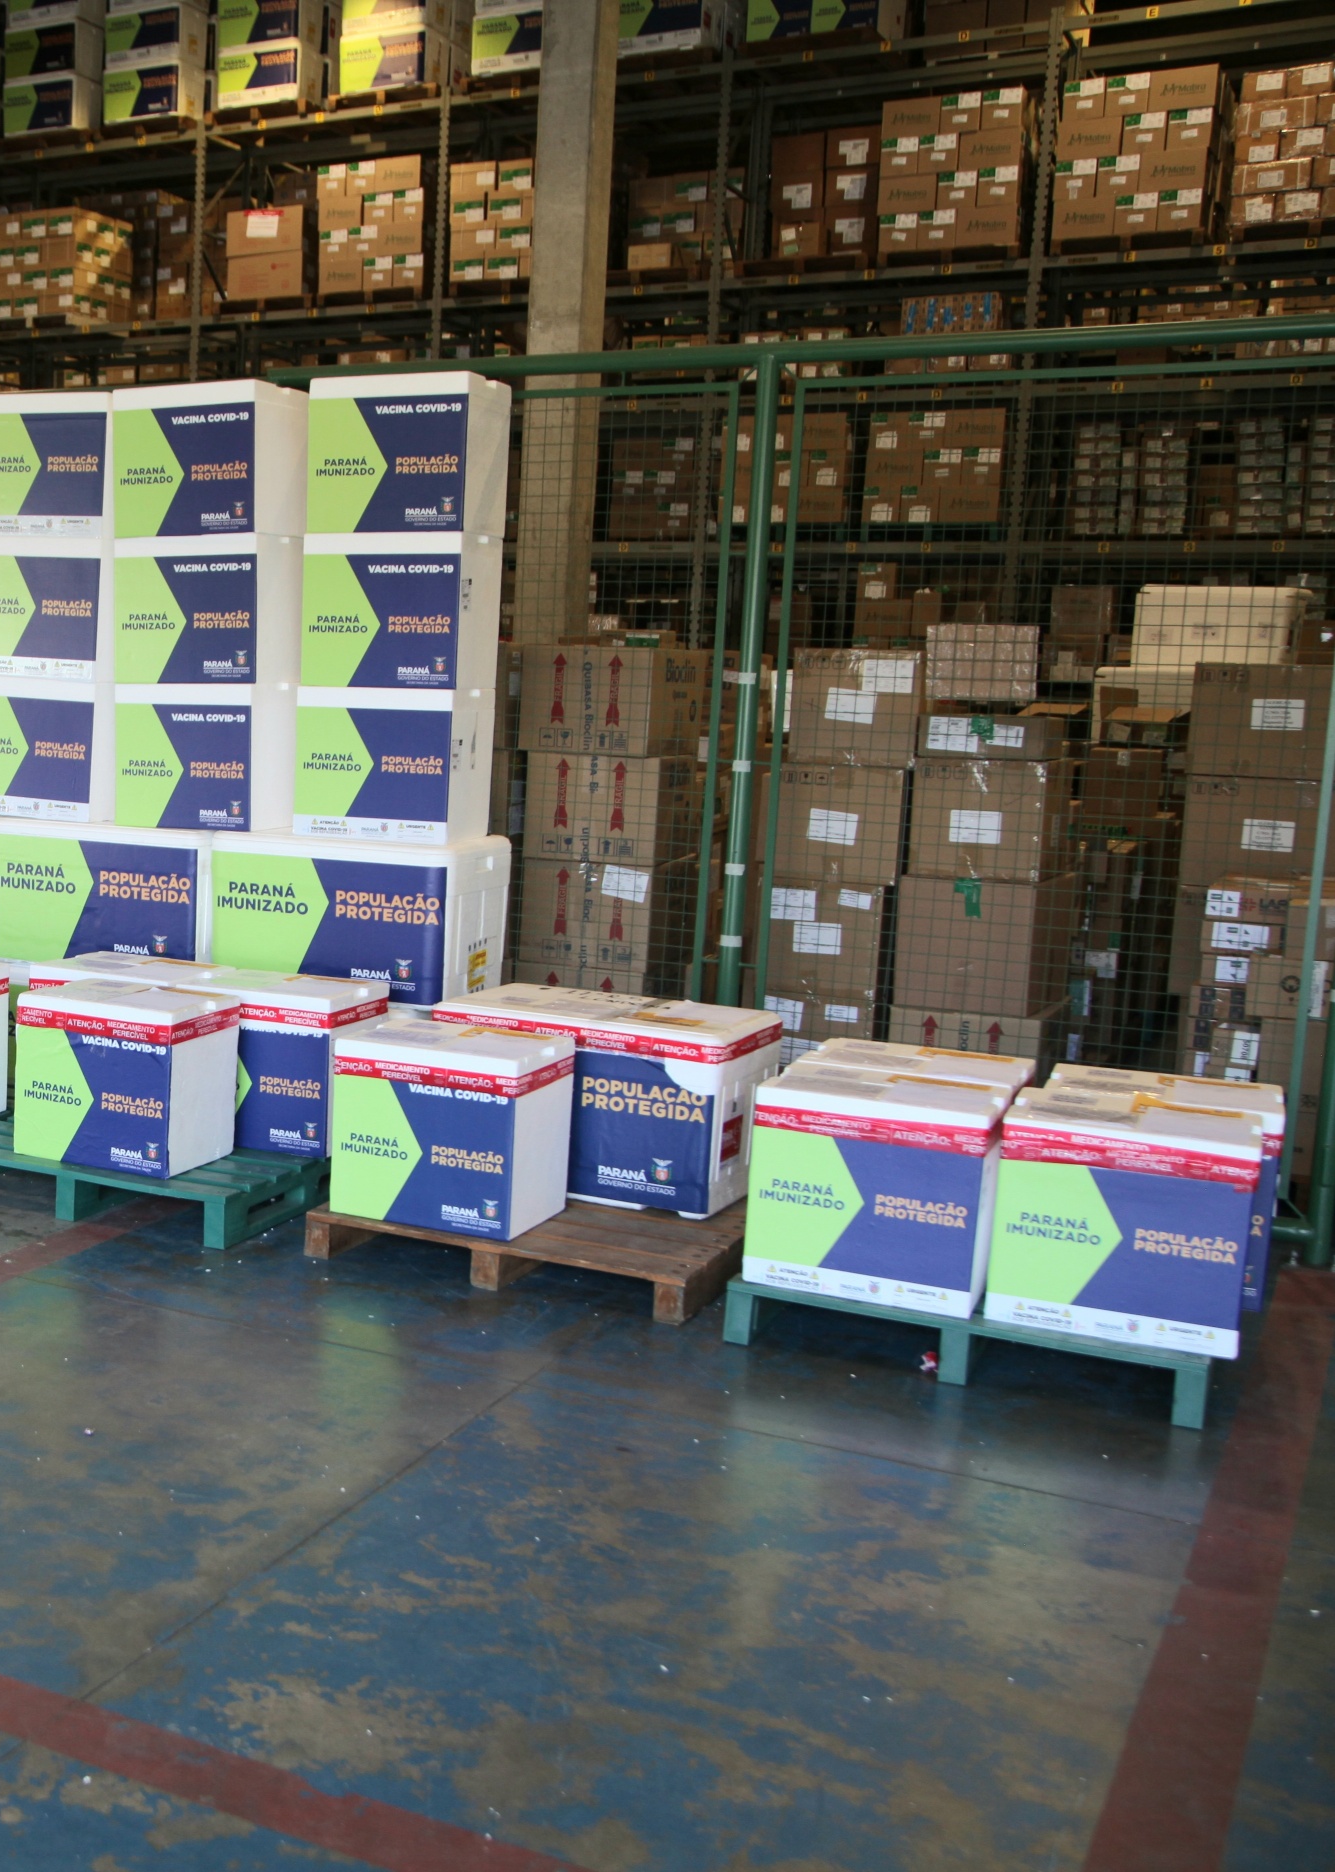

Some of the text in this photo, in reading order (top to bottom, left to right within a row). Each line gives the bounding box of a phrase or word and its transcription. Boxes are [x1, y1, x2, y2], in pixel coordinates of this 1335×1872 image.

[1149, 8, 1157, 17] E
[1307, 238, 1315, 248] D
[375, 403, 462, 415] VACINA COVID-19
[171, 411, 249, 425] VACINA COVID-19
[47, 454, 99, 464] POPULAÇÃO
[324, 456, 367, 467] PARANÁ
[396, 454, 458, 465] POPULAÇÃO
[47, 463, 98, 472] PROTEGIDA
[127, 466, 166, 476] PARANÁ
[191, 461, 248, 472] POPULAÇÃO
[316, 467, 375, 476] IMUNIZADO
[395, 464, 458, 474] PROTEGIDA
[120, 475, 174, 486] IMUNIZADO
[191, 470, 248, 481] PROTEGIDA
[201, 511, 230, 520] PARANÁ
[405, 506, 437, 515] PARANÁ
[368, 564, 454, 573] VACINA COVID-19
[317, 614, 360, 624] PARANÁ
[388, 614, 451, 625] POPULAÇÃO
[308, 624, 368, 634] IMUNIZADO
[388, 624, 450, 634] PROTEGIDA
[171, 713, 246, 722] VACINA COVID-19
[311, 752, 354, 762] PARANÁ
[381, 755, 443, 766] POPULAÇÃO
[303, 762, 362, 772] IMUNIZADO
[381, 764, 442, 775] PROTEGIDA
[7, 862, 64, 878] PARANÁ
[99, 870, 191, 890] POPULAÇÃO
[99, 885, 190, 904] PROTEGIDA
[229, 881, 296, 898] PARANÁ
[217, 896, 308, 915] IMUNIZADO
[335, 890, 440, 911] POPULAÇÃO
[335, 907, 439, 925] PROTEGIDA
[114, 943, 149, 955] PARANÁ
[351, 968, 391, 980] PARANÁ
[67, 1019, 105, 1031] ATENÇÃO:
[107, 1021, 155, 1034] MEDICAMENTO
[113, 1029, 148, 1041] PERECÍVEL
[580, 1028, 635, 1043] MEDICAMENTO
[82, 1035, 166, 1055] VACINA COVID-19
[586, 1037, 627, 1050] PERECÍVEL
[32, 1080, 74, 1095] PARANÁ
[259, 1076, 321, 1091] POPULAÇÃO
[24, 1089, 82, 1106] IMUNIZADO
[259, 1085, 320, 1100] PROTEGIDA
[408, 1083, 509, 1105] VACINA COVID-19
[583, 1075, 707, 1107] POPULAÇÃO
[102, 1092, 163, 1110] POPULAÇÃO
[581, 1092, 706, 1124] PROTEGIDA
[101, 1101, 163, 1119] PROTEGIDA
[350, 1132, 399, 1148] PARANÁ
[341, 1142, 408, 1160] IMUNIZADO
[431, 1145, 504, 1164] POPULAÇÃO
[431, 1155, 503, 1174] PROTEGIDA
[598, 1164, 647, 1181] PARANÁ
[598, 1178, 675, 1195] GOVERNO DO ESTADO
[772, 1178, 834, 1197] PARANÁ
[759, 1189, 845, 1211] IMUNIZADO
[875, 1193, 969, 1217] POPULAÇÃO
[874, 1205, 966, 1228] PROTEGIDA
[1020, 1211, 1089, 1231] PARANÁ
[1006, 1222, 1102, 1246] IMUNIZADO
[1134, 1228, 1238, 1253] POPULAÇÃO
[1134, 1240, 1236, 1265] PROTEGIDA
